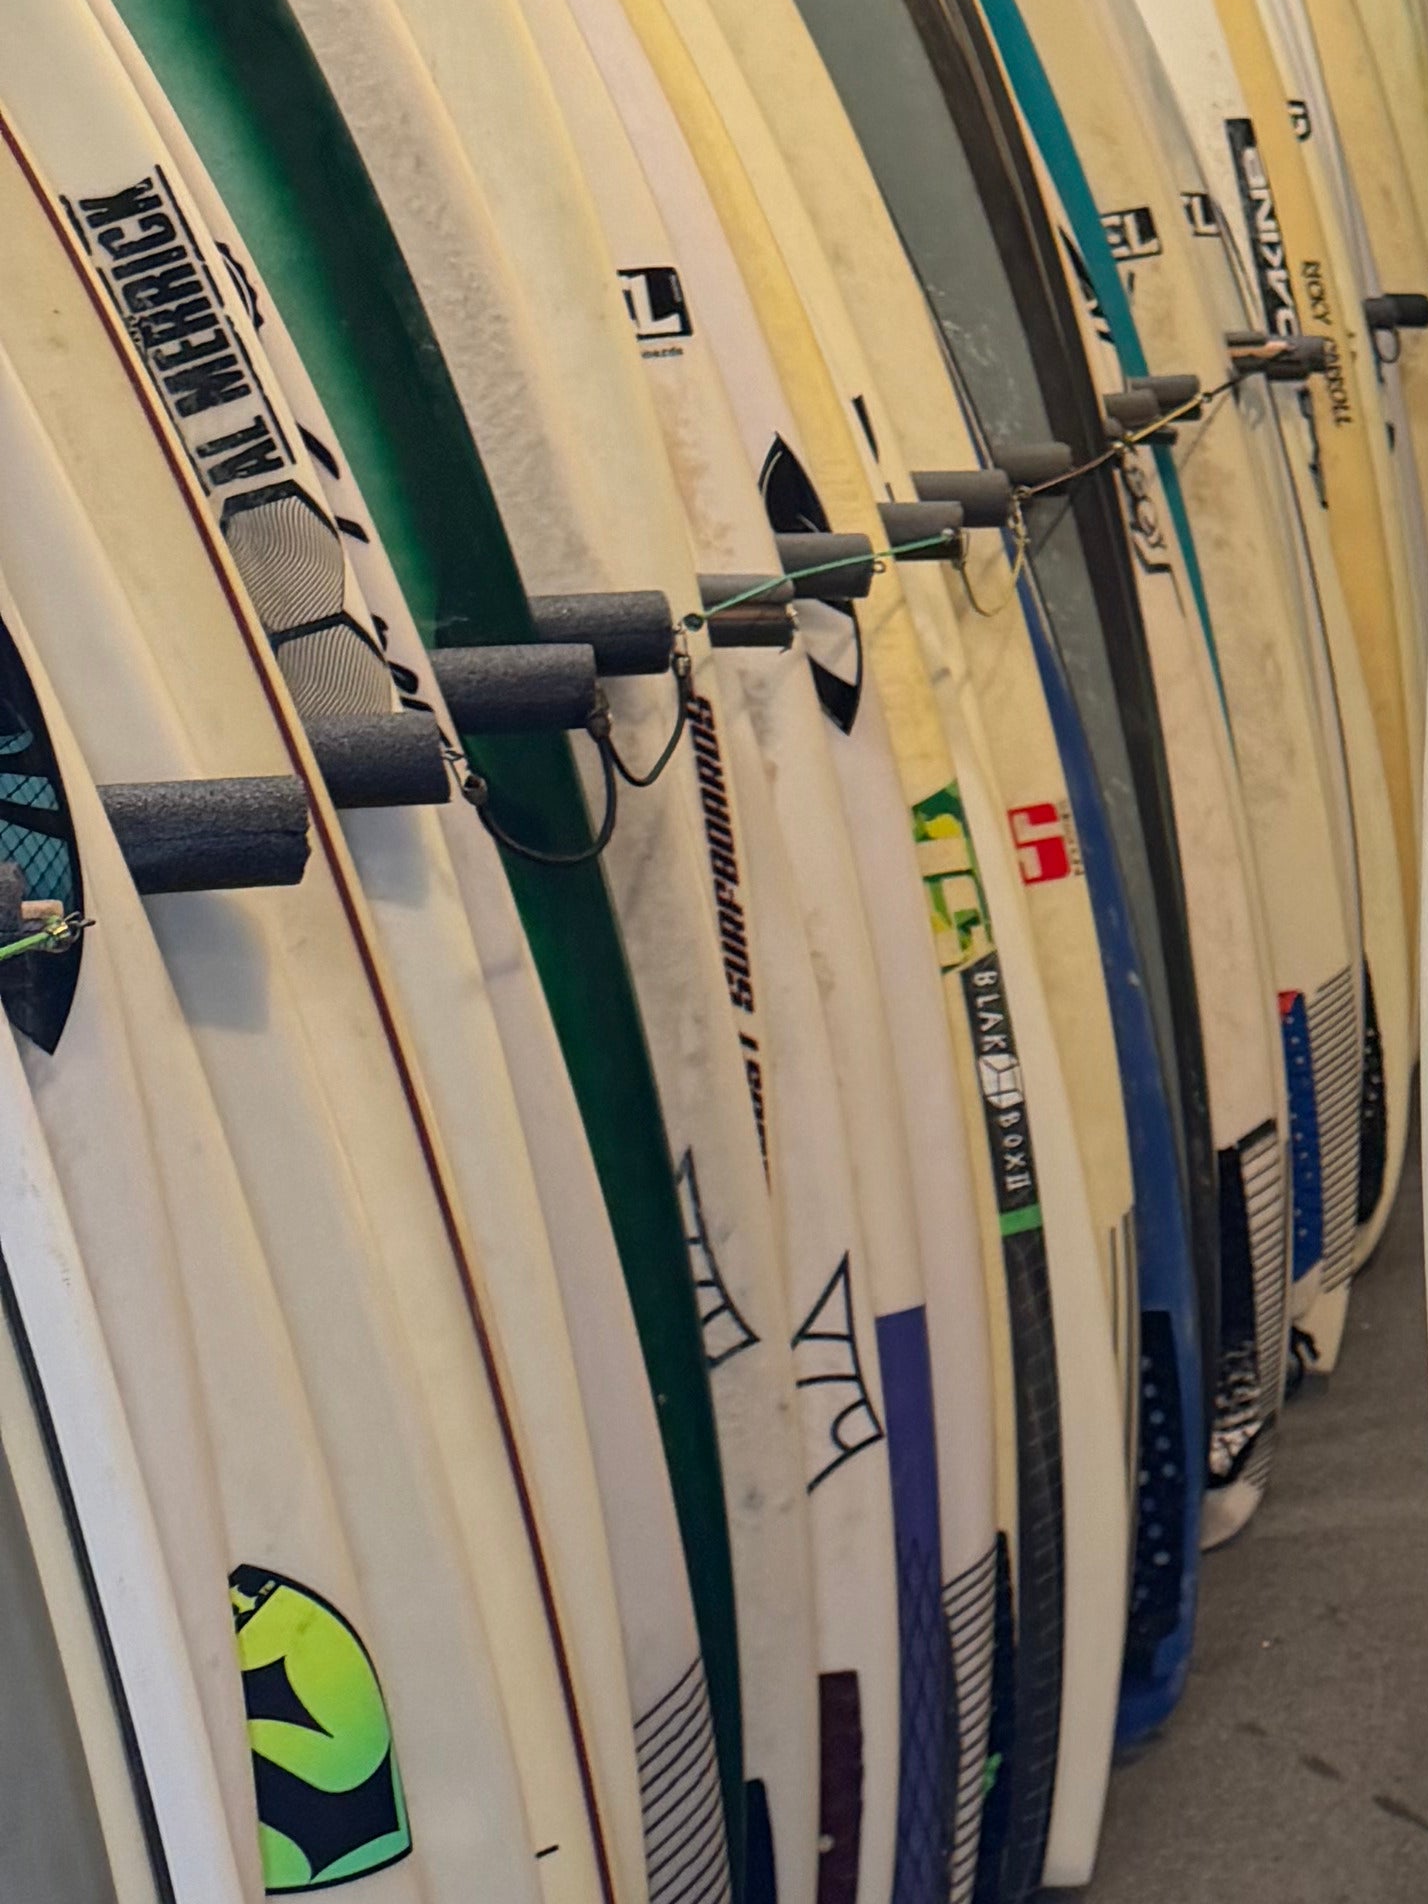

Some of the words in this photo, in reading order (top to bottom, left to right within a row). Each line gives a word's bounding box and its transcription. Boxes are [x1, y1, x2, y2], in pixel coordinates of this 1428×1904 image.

[78, 176, 252, 419] MERRICK
[196, 415, 285, 486] AL
[686, 696, 756, 1015] SURFBOARDS
[973, 970, 1009, 1052] BLAK
[999, 1111, 1029, 1172] BOX
